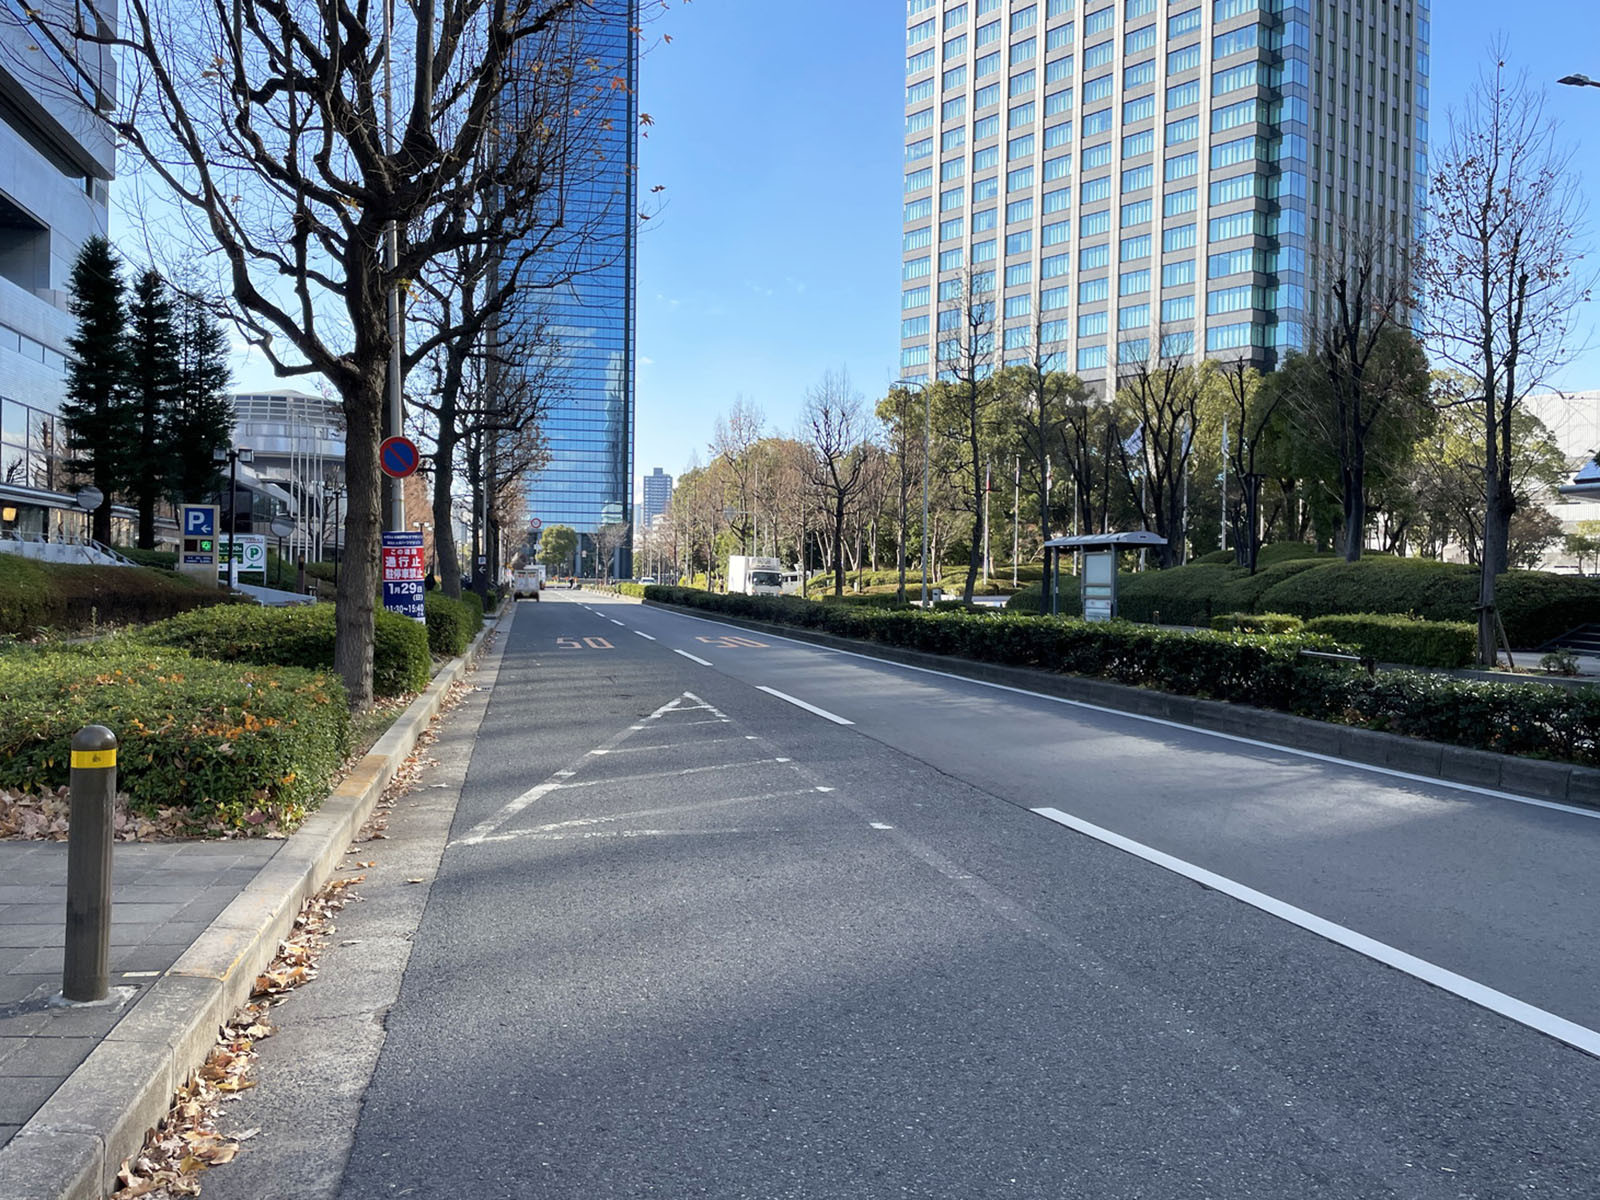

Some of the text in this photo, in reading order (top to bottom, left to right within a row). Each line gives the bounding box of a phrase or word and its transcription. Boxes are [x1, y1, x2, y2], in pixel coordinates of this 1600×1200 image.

[188, 511, 205, 531] P
[250, 547, 259, 558] P
[385, 556, 421, 567] 通行止
[388, 582, 423, 595] 1月29日
[556, 636, 615, 649] 50
[696, 636, 771, 648] 50
